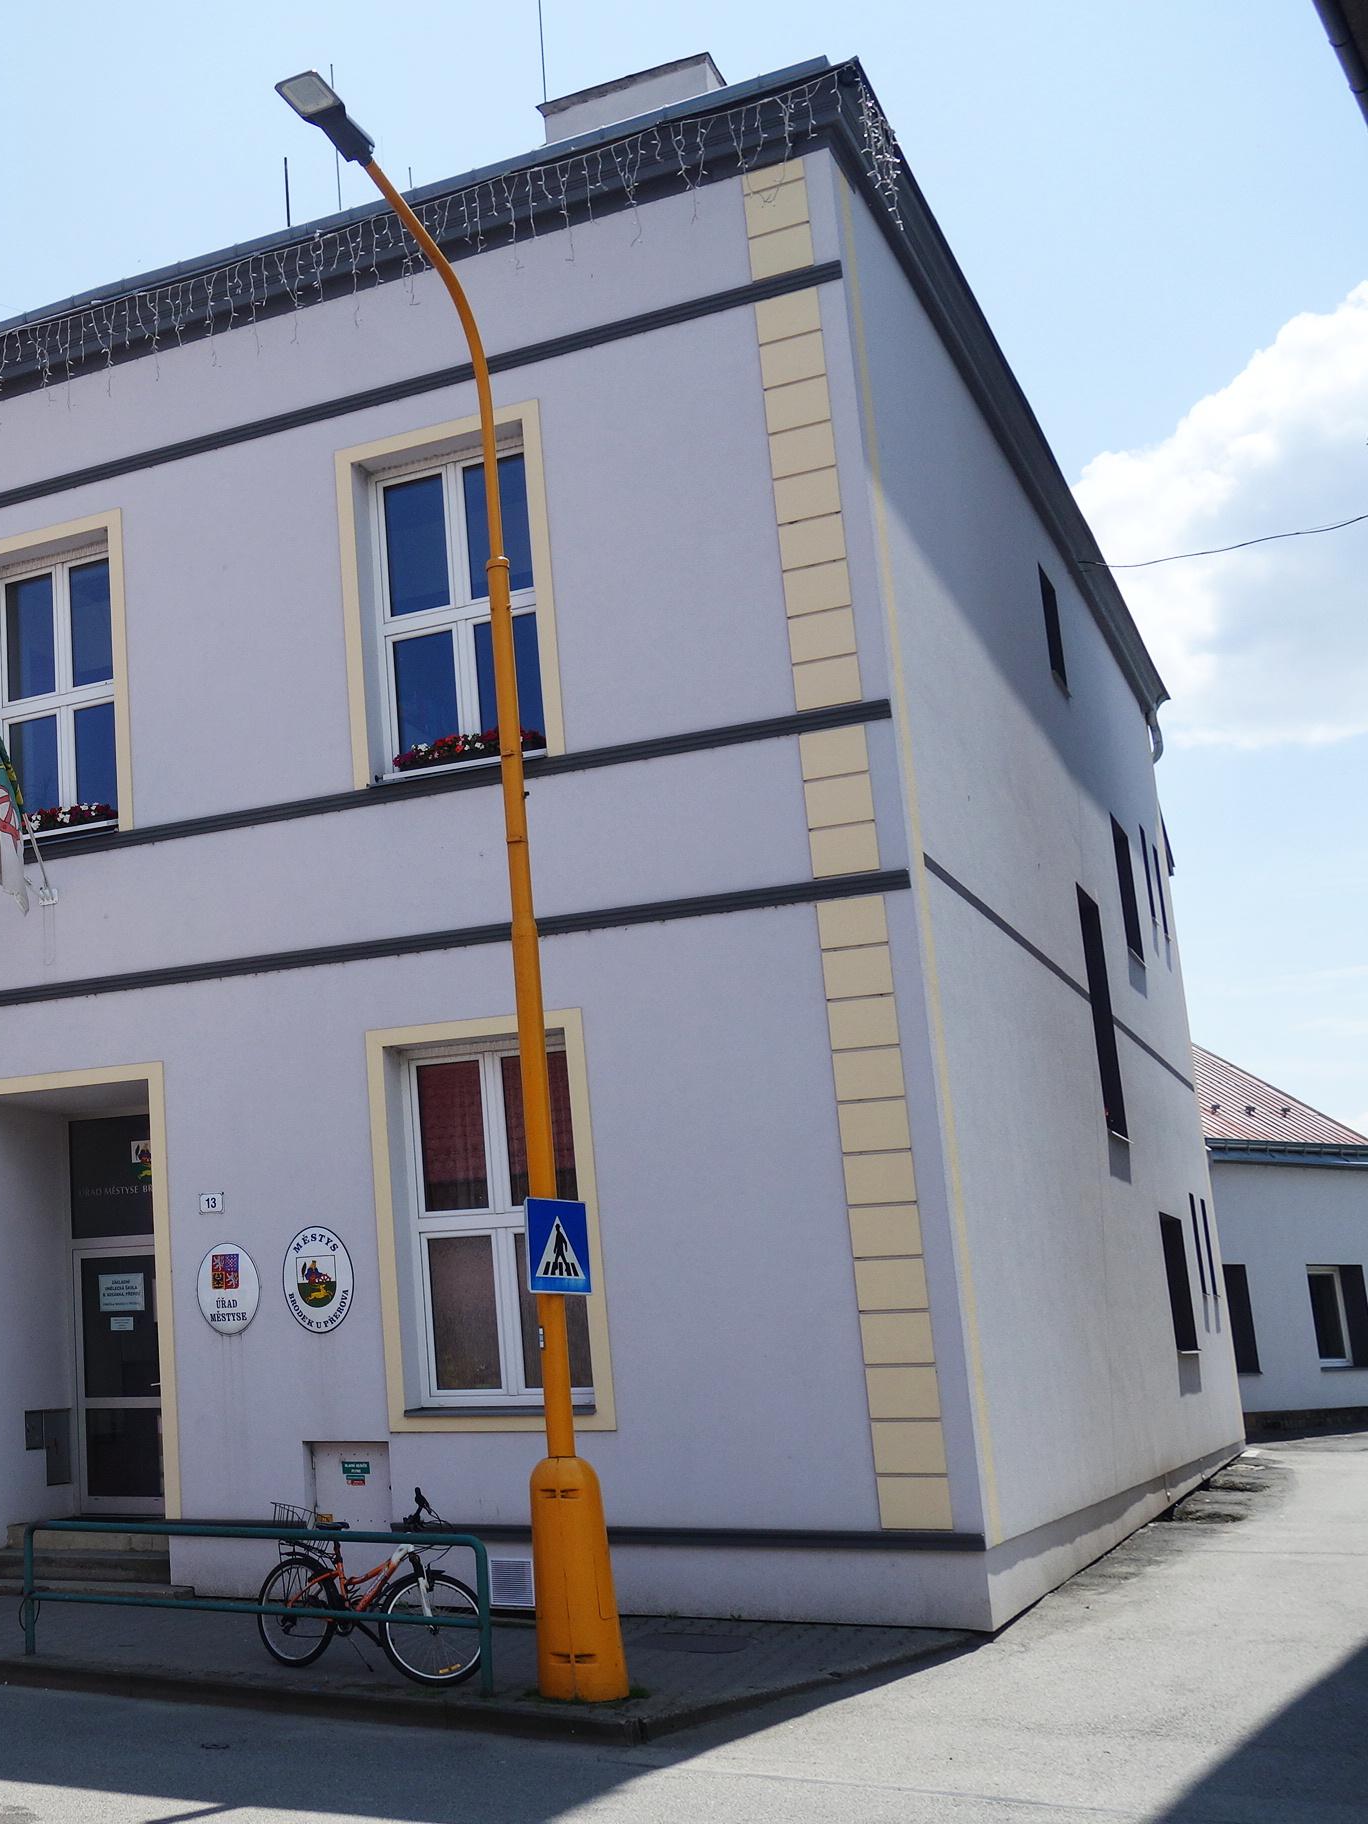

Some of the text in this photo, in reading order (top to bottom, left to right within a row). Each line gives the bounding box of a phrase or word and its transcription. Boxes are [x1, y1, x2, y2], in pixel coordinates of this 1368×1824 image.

[205, 1197, 217, 1209] 13
[293, 1233, 339, 1254] MĚSTYS
[215, 1297, 238, 1309] ÚŘAD
[288, 1293, 314, 1328] BRODEK
[323, 1289, 349, 1328] PŘEROVA
[210, 1311, 247, 1322] MĚSTYSE
